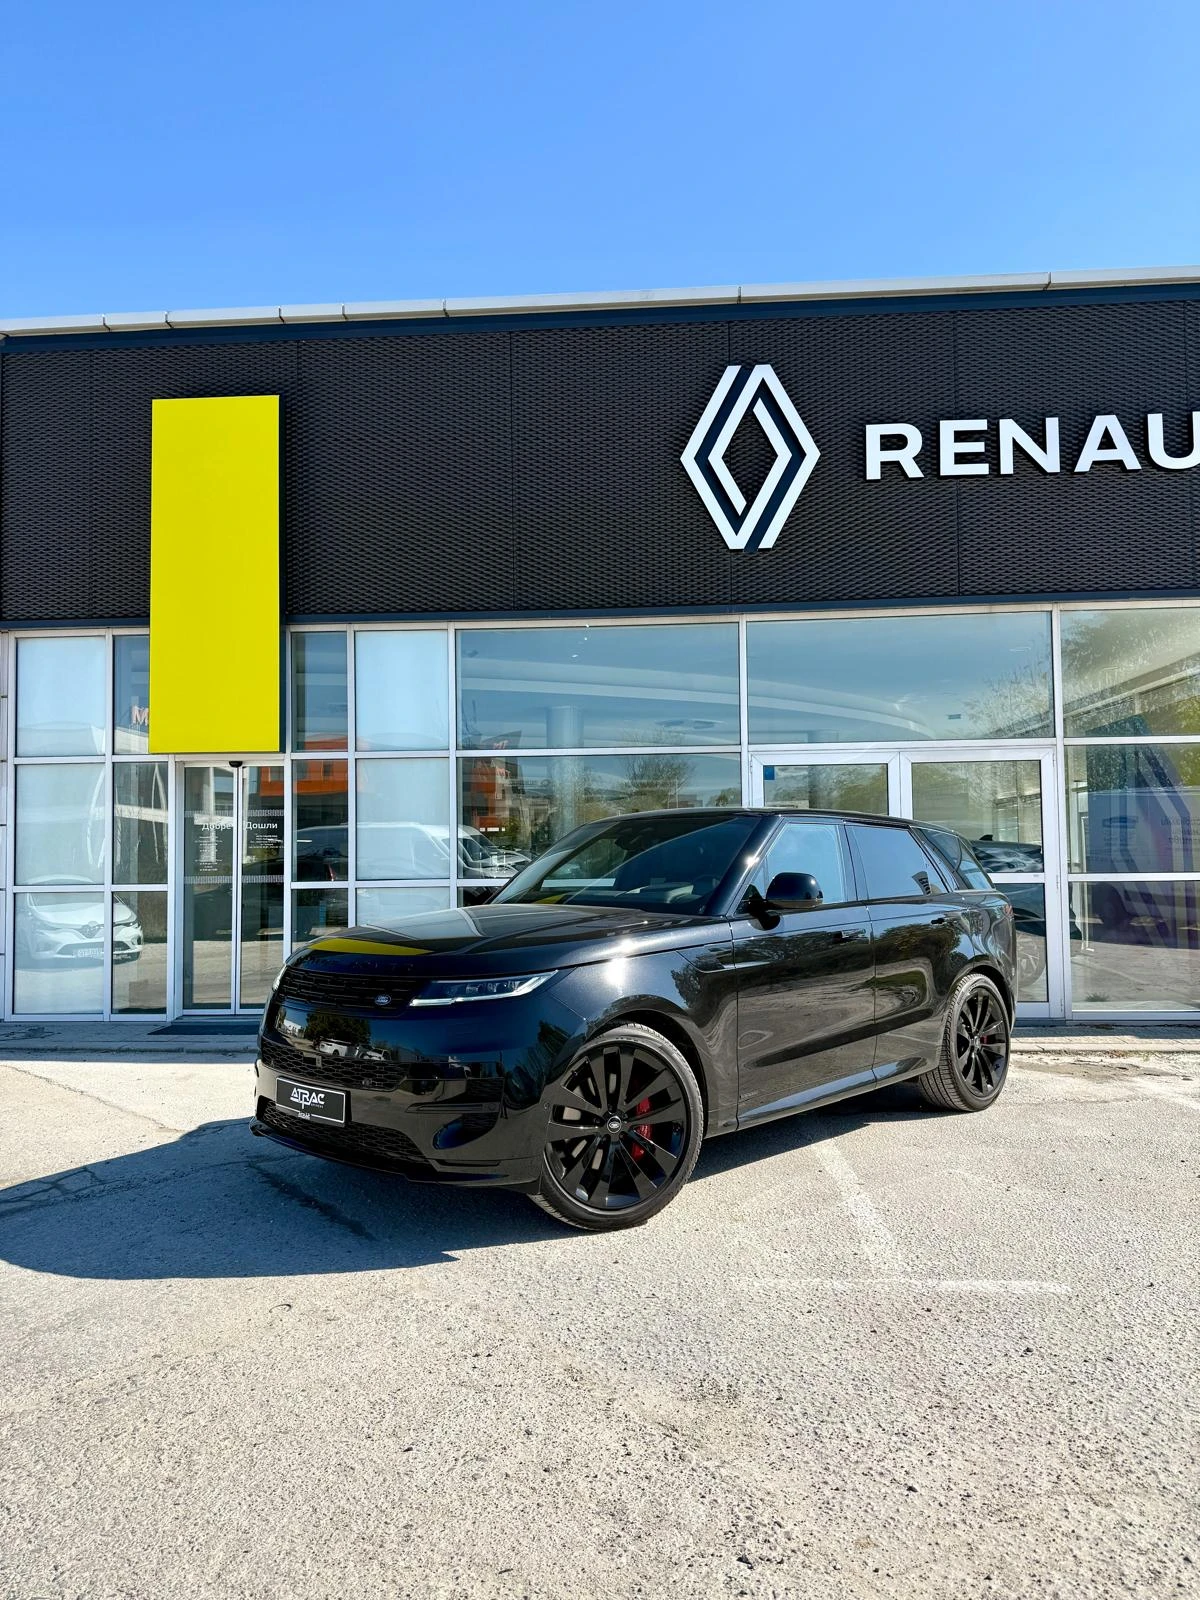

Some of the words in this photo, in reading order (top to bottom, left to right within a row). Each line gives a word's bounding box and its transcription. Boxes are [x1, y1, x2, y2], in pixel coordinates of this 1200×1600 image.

[865, 411, 1200, 480] RENAU
[202, 822, 232, 831] Добре
[243, 821, 278, 831] Дошли
[290, 1087, 325, 1109] ATRAC
